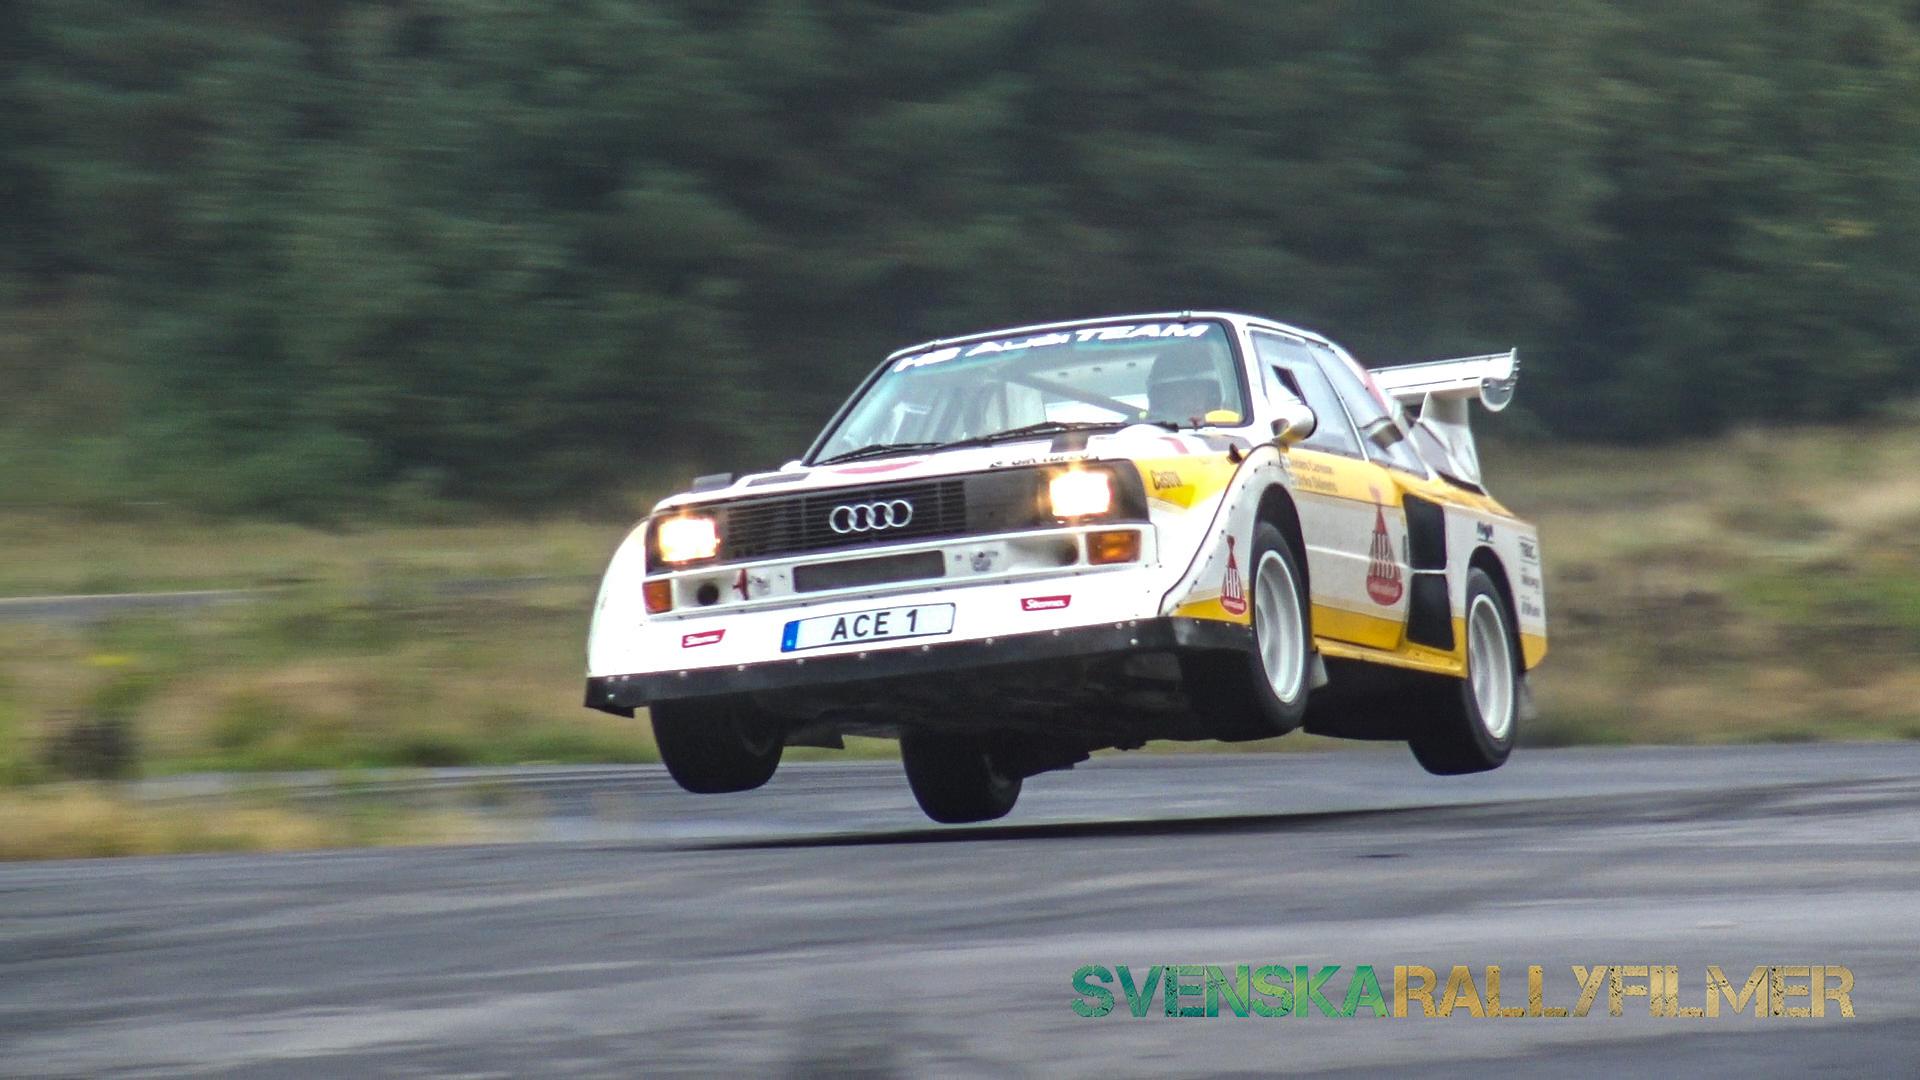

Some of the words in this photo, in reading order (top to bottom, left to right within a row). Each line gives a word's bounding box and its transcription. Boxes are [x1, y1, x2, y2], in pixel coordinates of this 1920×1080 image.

[1076, 324, 1209, 342] TEAM
[830, 612, 891, 641] ACE
[906, 609, 918, 632] 1
